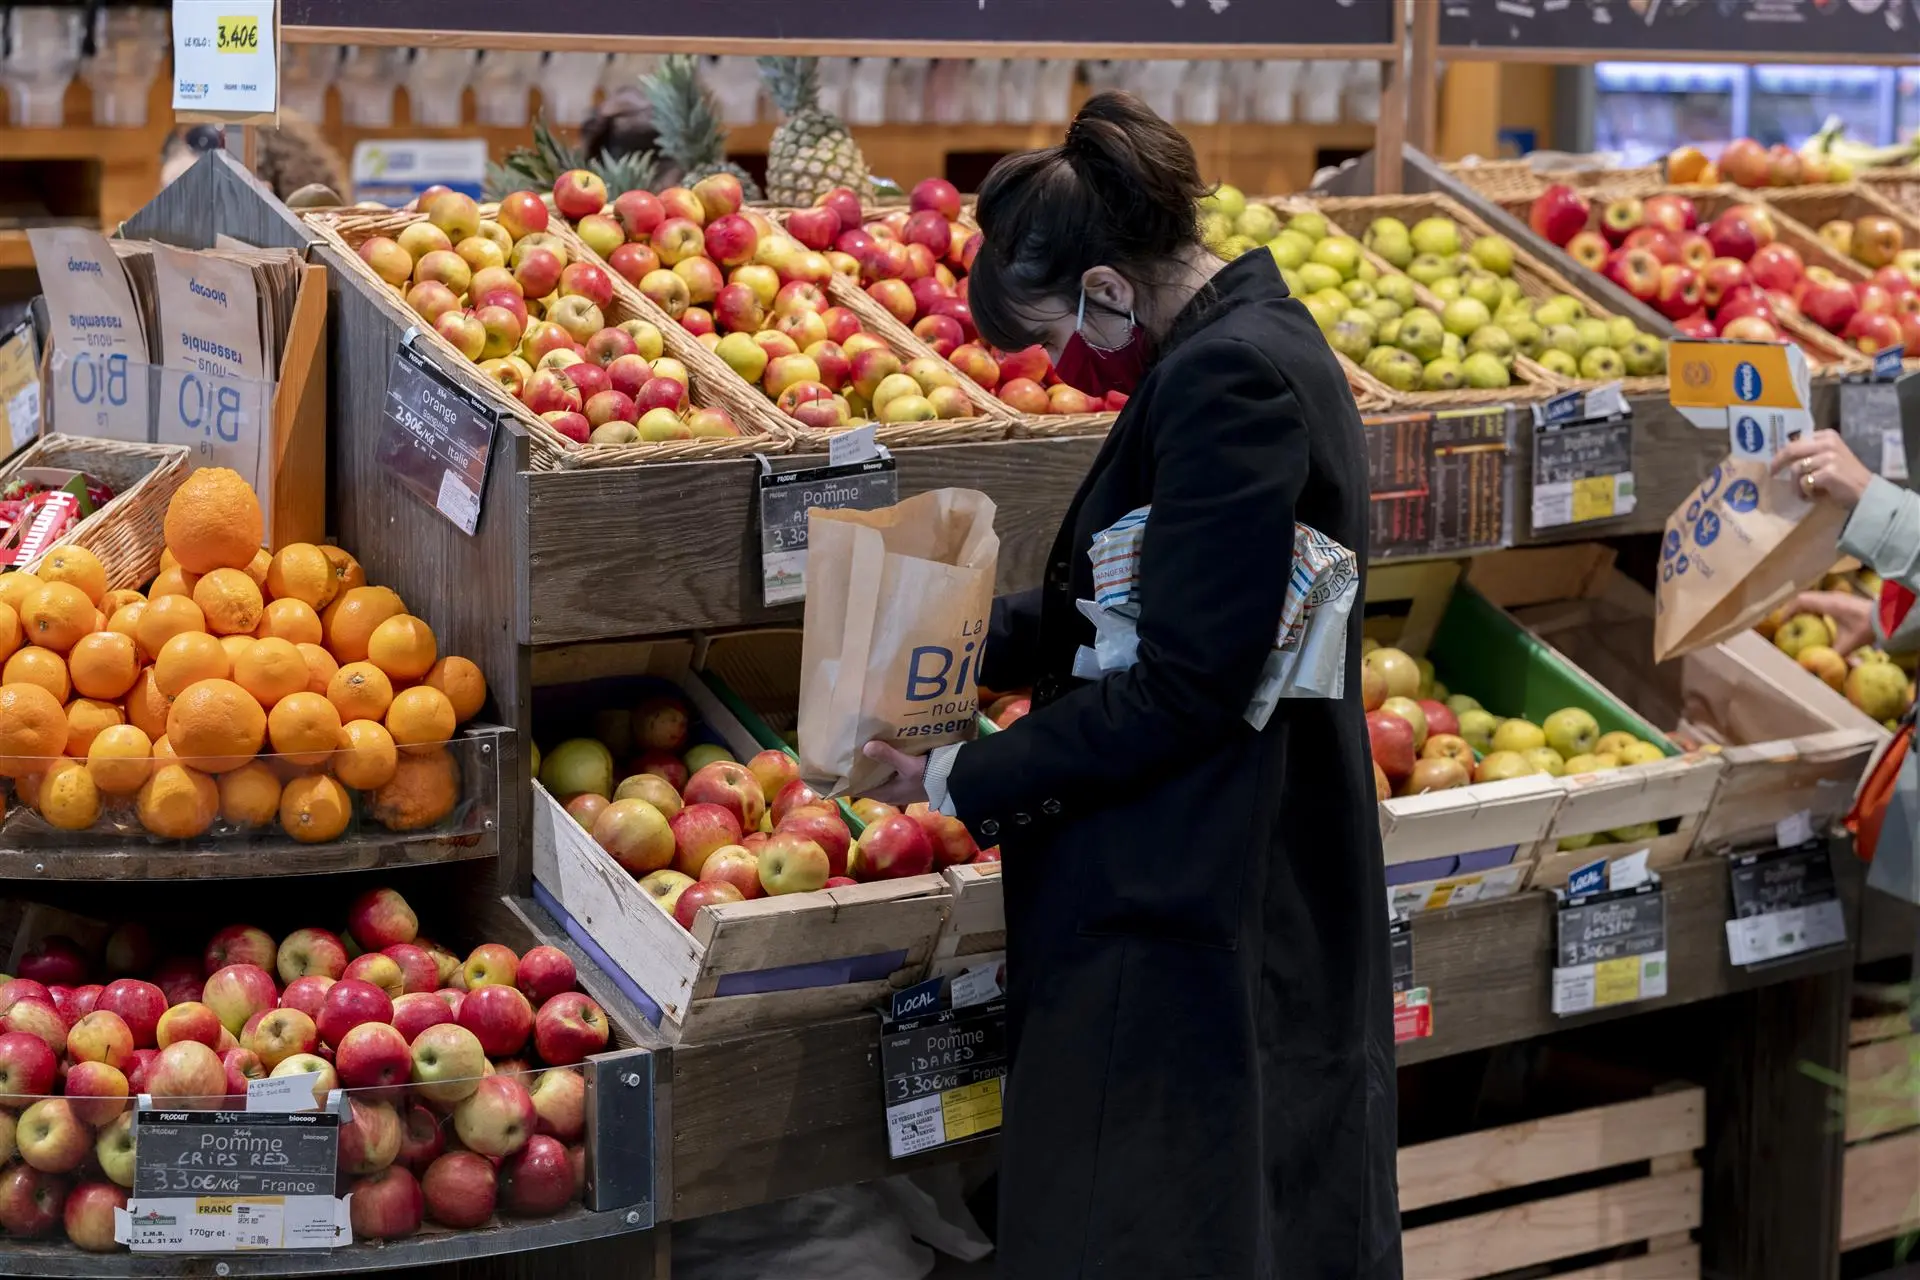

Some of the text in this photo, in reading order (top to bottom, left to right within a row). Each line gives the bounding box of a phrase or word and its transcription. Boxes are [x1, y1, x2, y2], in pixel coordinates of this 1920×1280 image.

[217, 25, 258, 48] 3.40€
[180, 81, 208, 98] biocoop
[68, 257, 103, 276] biocoop
[190, 278, 227, 307] biocoop
[70, 315, 122, 329] rassemble
[88, 337, 112, 346] nous
[182, 333, 242, 364] rassemble
[198, 360, 226, 377] nous
[422, 389, 457, 425] Orange
[447, 445, 469, 469] Italie
[777, 474, 797, 483] PRODUIT
[803, 487, 859, 506] Pomme
[774, 528, 808, 548] 3.30
[962, 619, 983, 637] La
[932, 698, 977, 717] nous
[1570, 870, 1601, 893] LOCAL
[897, 991, 936, 1017] LOCAL
[927, 1030, 985, 1053] Pomme
[972, 1066, 1008, 1081] Franc
[160, 1112, 189, 1121] PRODUIT
[215, 1112, 238, 1123] 344
[201, 1133, 283, 1152] Pomme
[250, 1153, 289, 1166] RED
[261, 1179, 316, 1194] France
[198, 1205, 233, 1214] FRANC
[189, 1228, 226, 1238] 170gr et
